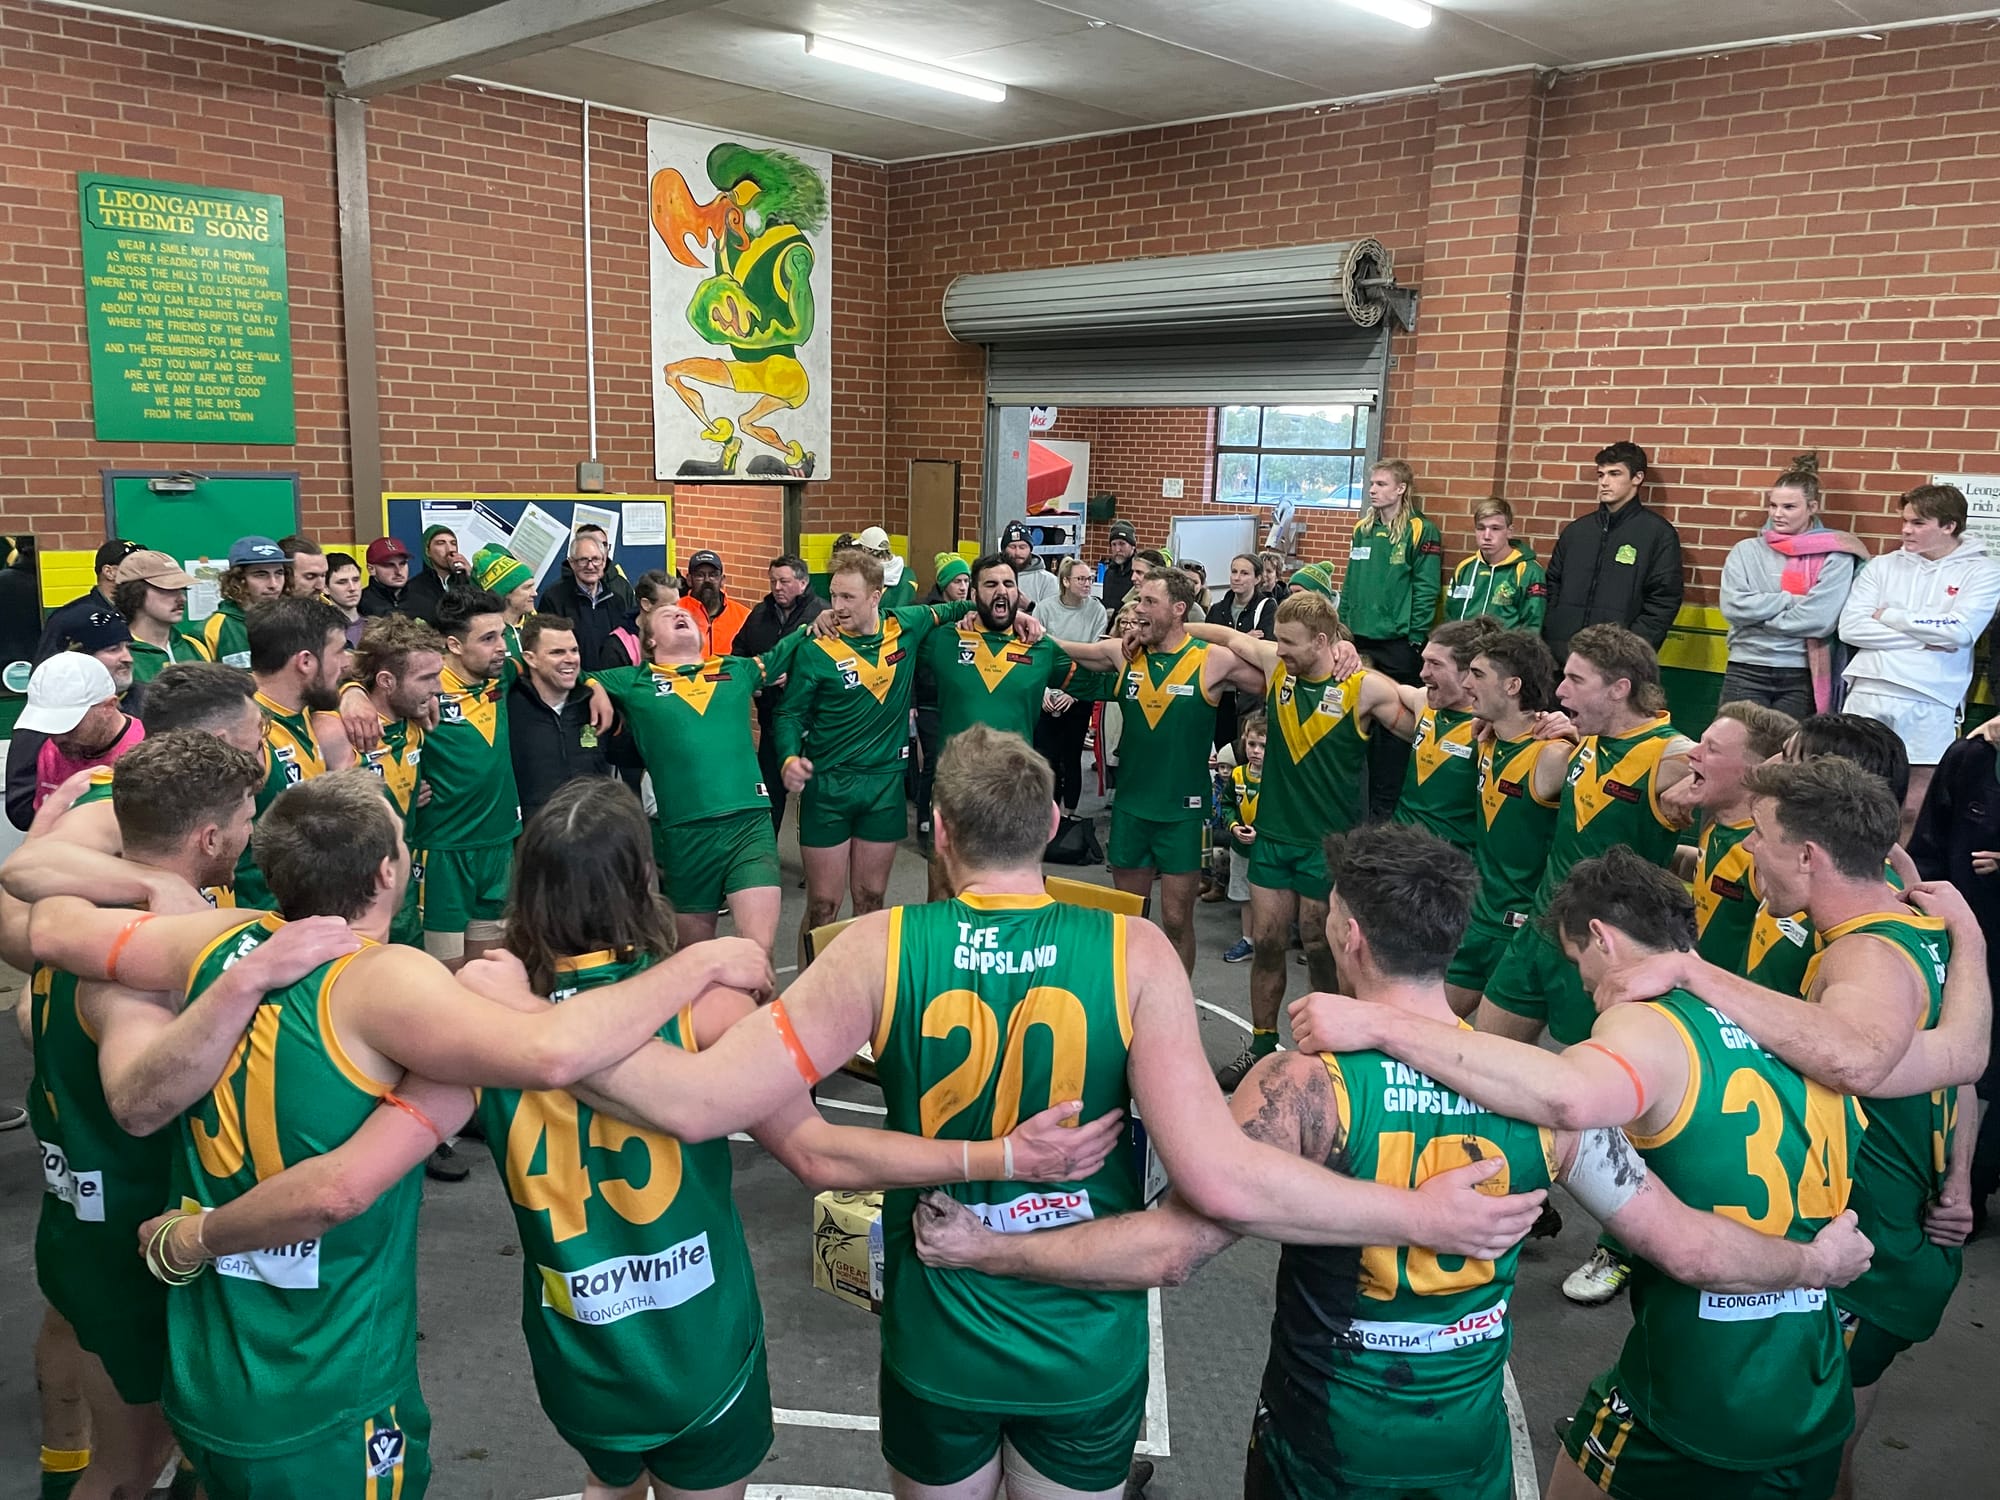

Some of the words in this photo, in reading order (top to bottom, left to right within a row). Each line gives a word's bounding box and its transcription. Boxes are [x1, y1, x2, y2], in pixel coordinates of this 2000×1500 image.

[96, 188, 268, 224] LEONGATHA'S
[98, 206, 194, 234] THEME
[205, 219, 270, 242] SONG
[117, 238, 145, 250] WEAR
[150, 242, 156, 251] A
[159, 243, 186, 254] SMILE
[191, 246, 209, 256] NOT
[213, 248, 219, 257] A
[223, 249, 254, 261] FROWN
[106, 250, 119, 261] AS
[123, 252, 152, 264] WE'RE
[157, 255, 197, 268] HEADING
[201, 259, 219, 270] FOR
[223, 261, 240, 272] THE
[244, 263, 269, 274] TOWN
[106, 264, 146, 276] ACROSS
[151, 267, 167, 278] THE
[172, 269, 197, 280] HILLS
[201, 272, 212, 282] TO
[217, 273, 267, 286] LEONGATHA
[90, 275, 125, 288] WHERE
[130, 278, 148, 290] THE
[152, 280, 183, 293] GREEN
[198, 284, 232, 296] GOLD'S
[234, 288, 250, 298] THE
[254, 289, 282, 301] CAPER
[117, 291, 137, 301] AND
[141, 293, 160, 303] YOU
[164, 294, 183, 305] CAN
[187, 296, 211, 307] READ
[216, 298, 232, 308] THE
[236, 300, 263, 311] PAPER
[100, 302, 132, 314] ABOUT
[137, 305, 159, 316] HOW
[164, 307, 194, 318] THOSE
[198, 309, 238, 322] PARROTS
[242, 312, 260, 323] CAN
[264, 314, 278, 324] FLY
[107, 316, 141, 328] WHERE
[146, 319, 163, 329] THE
[168, 320, 206, 332] FRIENDS
[210, 323, 222, 333] OF
[226, 324, 242, 334] THE
[246, 326, 274, 337] GATHA
[145, 332, 163, 342] ARE
[168, 333, 204, 344] WAITING
[208, 336, 226, 346] FOR
[230, 337, 242, 347] ME
[104, 342, 124, 353] AND
[128, 343, 146, 354] THE
[150, 344, 216, 358] PREMIERSHIPS
[220, 349, 226, 359] A
[230, 349, 280, 362] CAKE-WALK
[139, 357, 162, 367] JUST
[167, 359, 185, 368] YOU
[189, 360, 210, 370] WAIT
[214, 361, 232, 371] AND
[236, 362, 252, 372] SEE
[123, 369, 142, 379] ARE
[146, 370, 160, 380] WE
[165, 371, 194, 381] GOOD!
[199, 372, 216, 382] ARE
[220, 374, 233, 383] WE
[238, 374, 266, 384] GOOD!
[130, 382, 149, 392] ARE
[153, 383, 168, 393] WE
[172, 384, 190, 394] ANY
[194, 385, 230, 396] BLOODY
[234, 387, 260, 397] GOOD
[155, 396, 169, 406] WE
[174, 397, 191, 406] ARE
[195, 398, 212, 407] THE
[217, 399, 240, 408] BOYS
[143, 408, 170, 419] FROM
[174, 409, 192, 419] THE
[195, 410, 225, 420] GATHA
[228, 411, 254, 421] TOWN
[1973, 500, 1993, 512] rich
[920, 986, 1087, 1140] 20
[1713, 1067, 1853, 1240] 34
[506, 1088, 683, 1243] 45
[1026, 1209, 1071, 1224] UTE
[836, 1261, 868, 1279] GREAT
[577, 1295, 657, 1322] LEONGATHA
